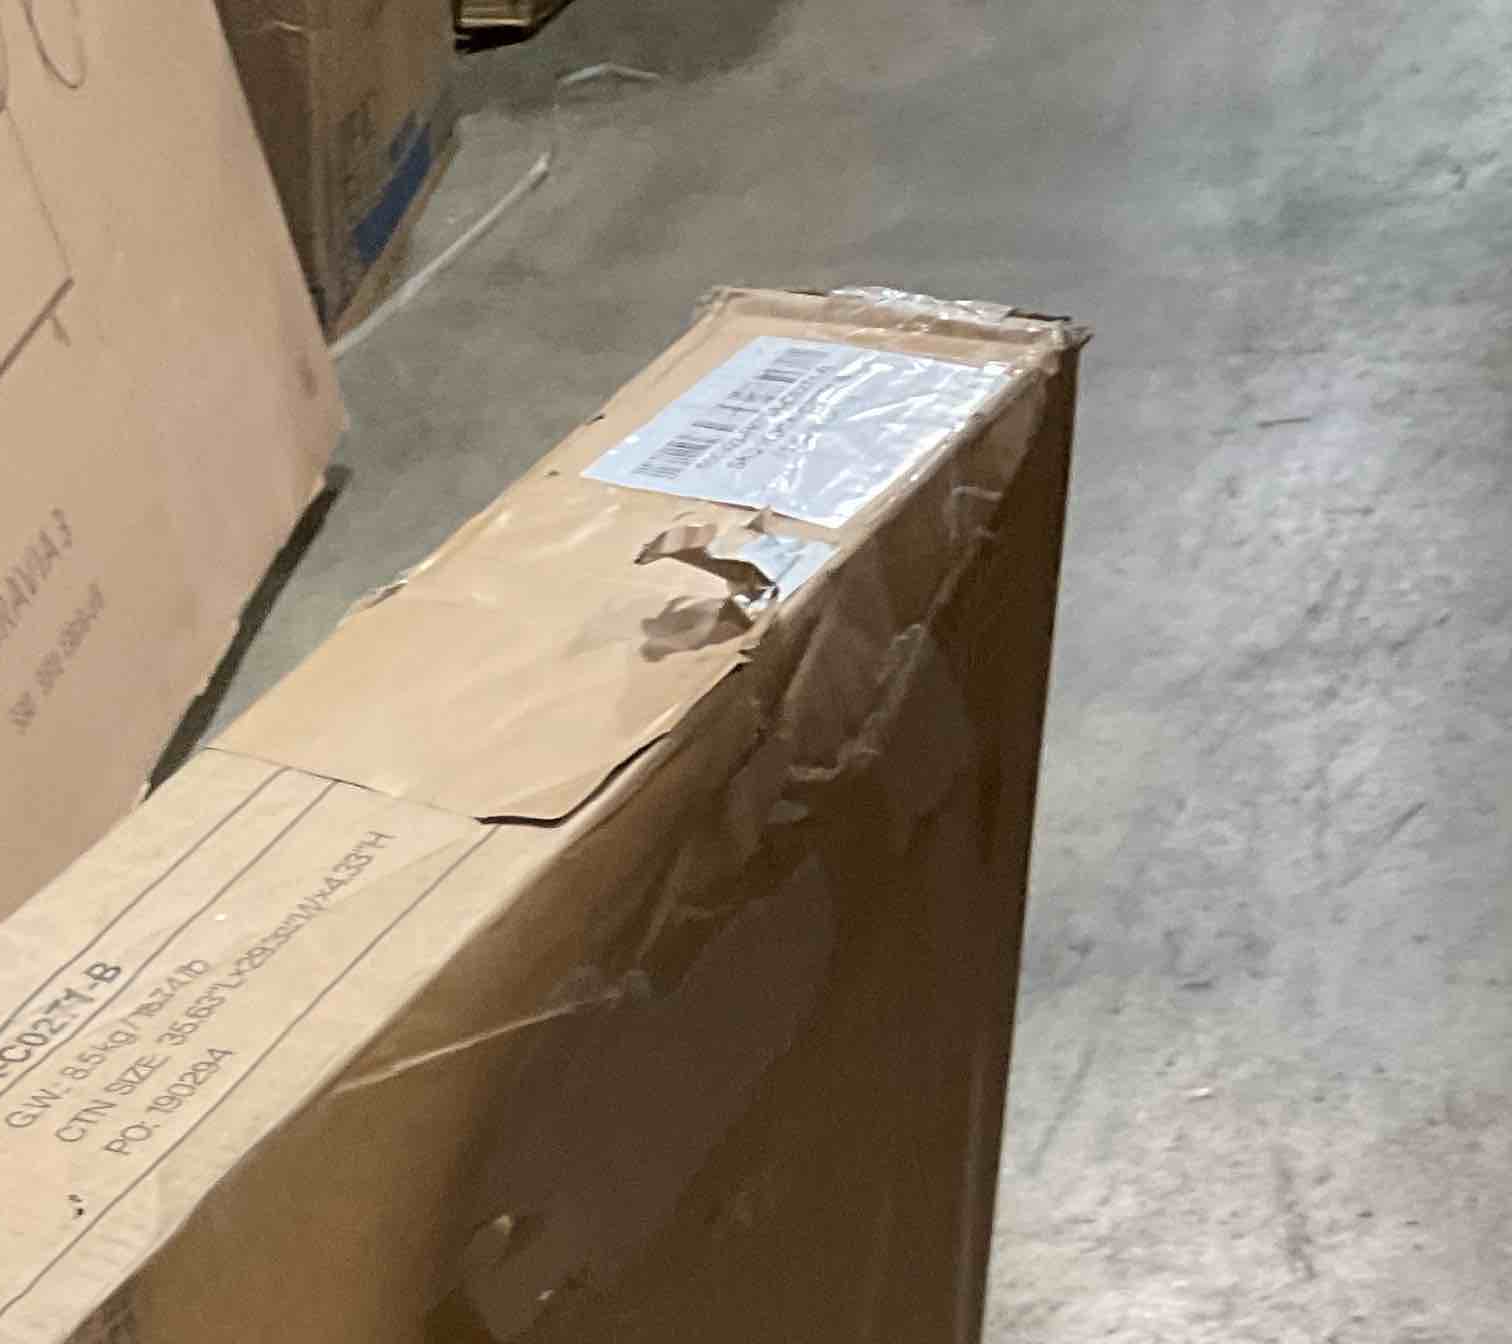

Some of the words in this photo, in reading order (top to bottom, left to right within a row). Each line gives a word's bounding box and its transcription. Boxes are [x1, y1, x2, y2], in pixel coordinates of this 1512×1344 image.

[50, 1095, 118, 1145] CTN
[101, 1115, 162, 1158] PO:
[144, 1046, 237, 1114] 190294
